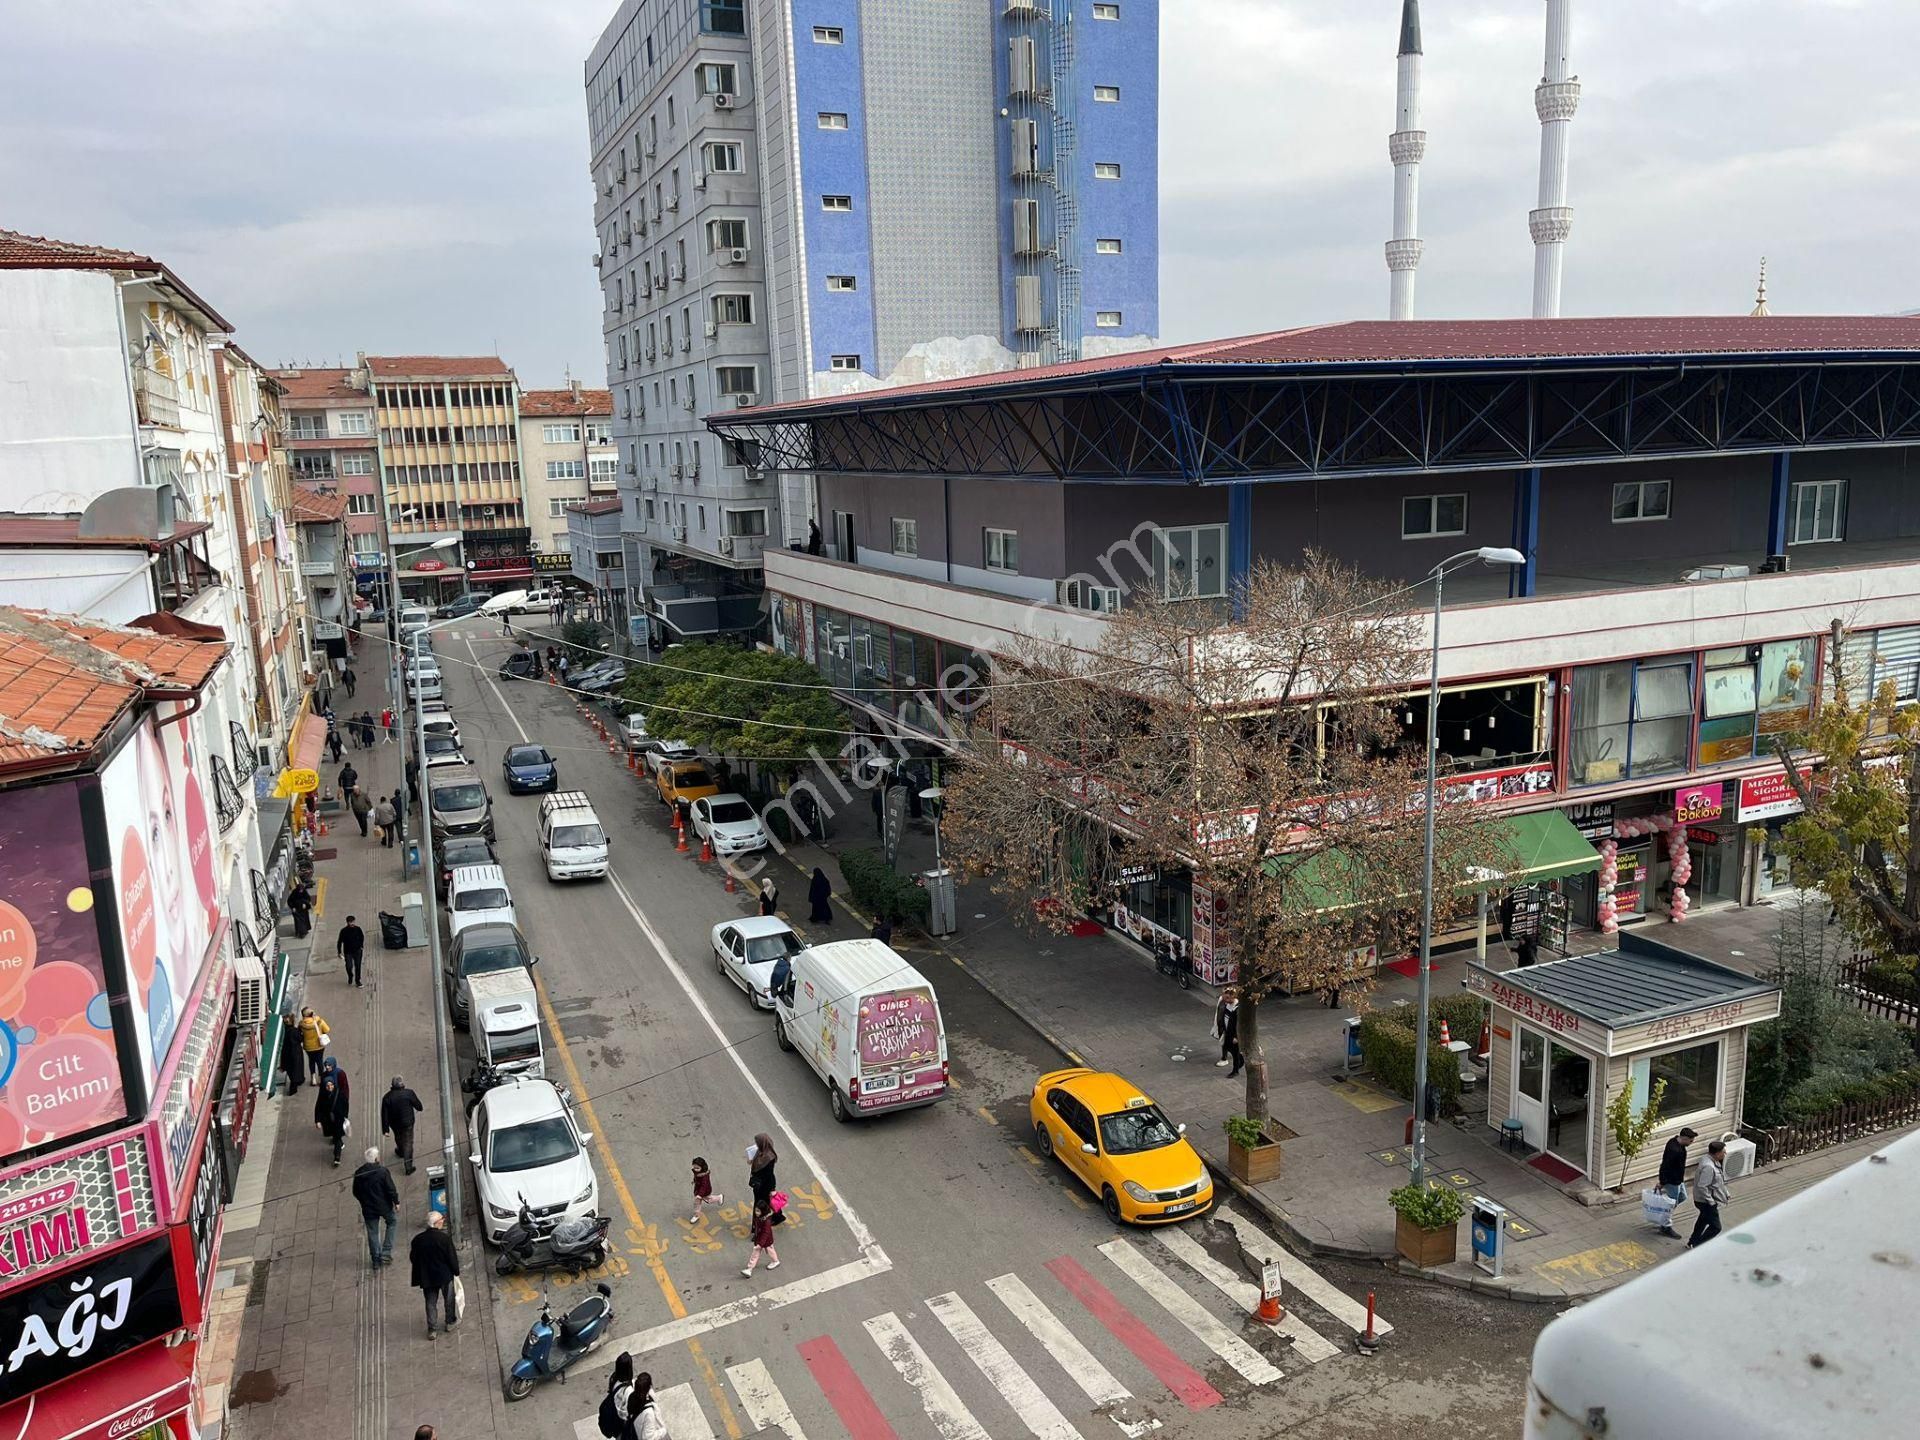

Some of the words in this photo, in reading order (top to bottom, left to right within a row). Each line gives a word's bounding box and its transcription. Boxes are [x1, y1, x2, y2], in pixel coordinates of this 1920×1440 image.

[1748, 777, 1778, 789] MEGA
[1593, 804, 1612, 818] GSM
[1616, 861, 1639, 871] AKLAVA
[1491, 981, 1533, 1010] ZAFER
[1539, 1002, 1579, 1031] TAKSİ
[1646, 1015, 1692, 1037] ZAFER
[1703, 1002, 1743, 1023] TAKSİ
[39, 1053, 83, 1083] Cilt
[26, 1074, 111, 1116] Bakımı
[2, 1202, 28, 1219] 212
[29, 1195, 46, 1209] 71
[48, 1188, 66, 1202] 72
[0, 1276, 133, 1376] AĞI
